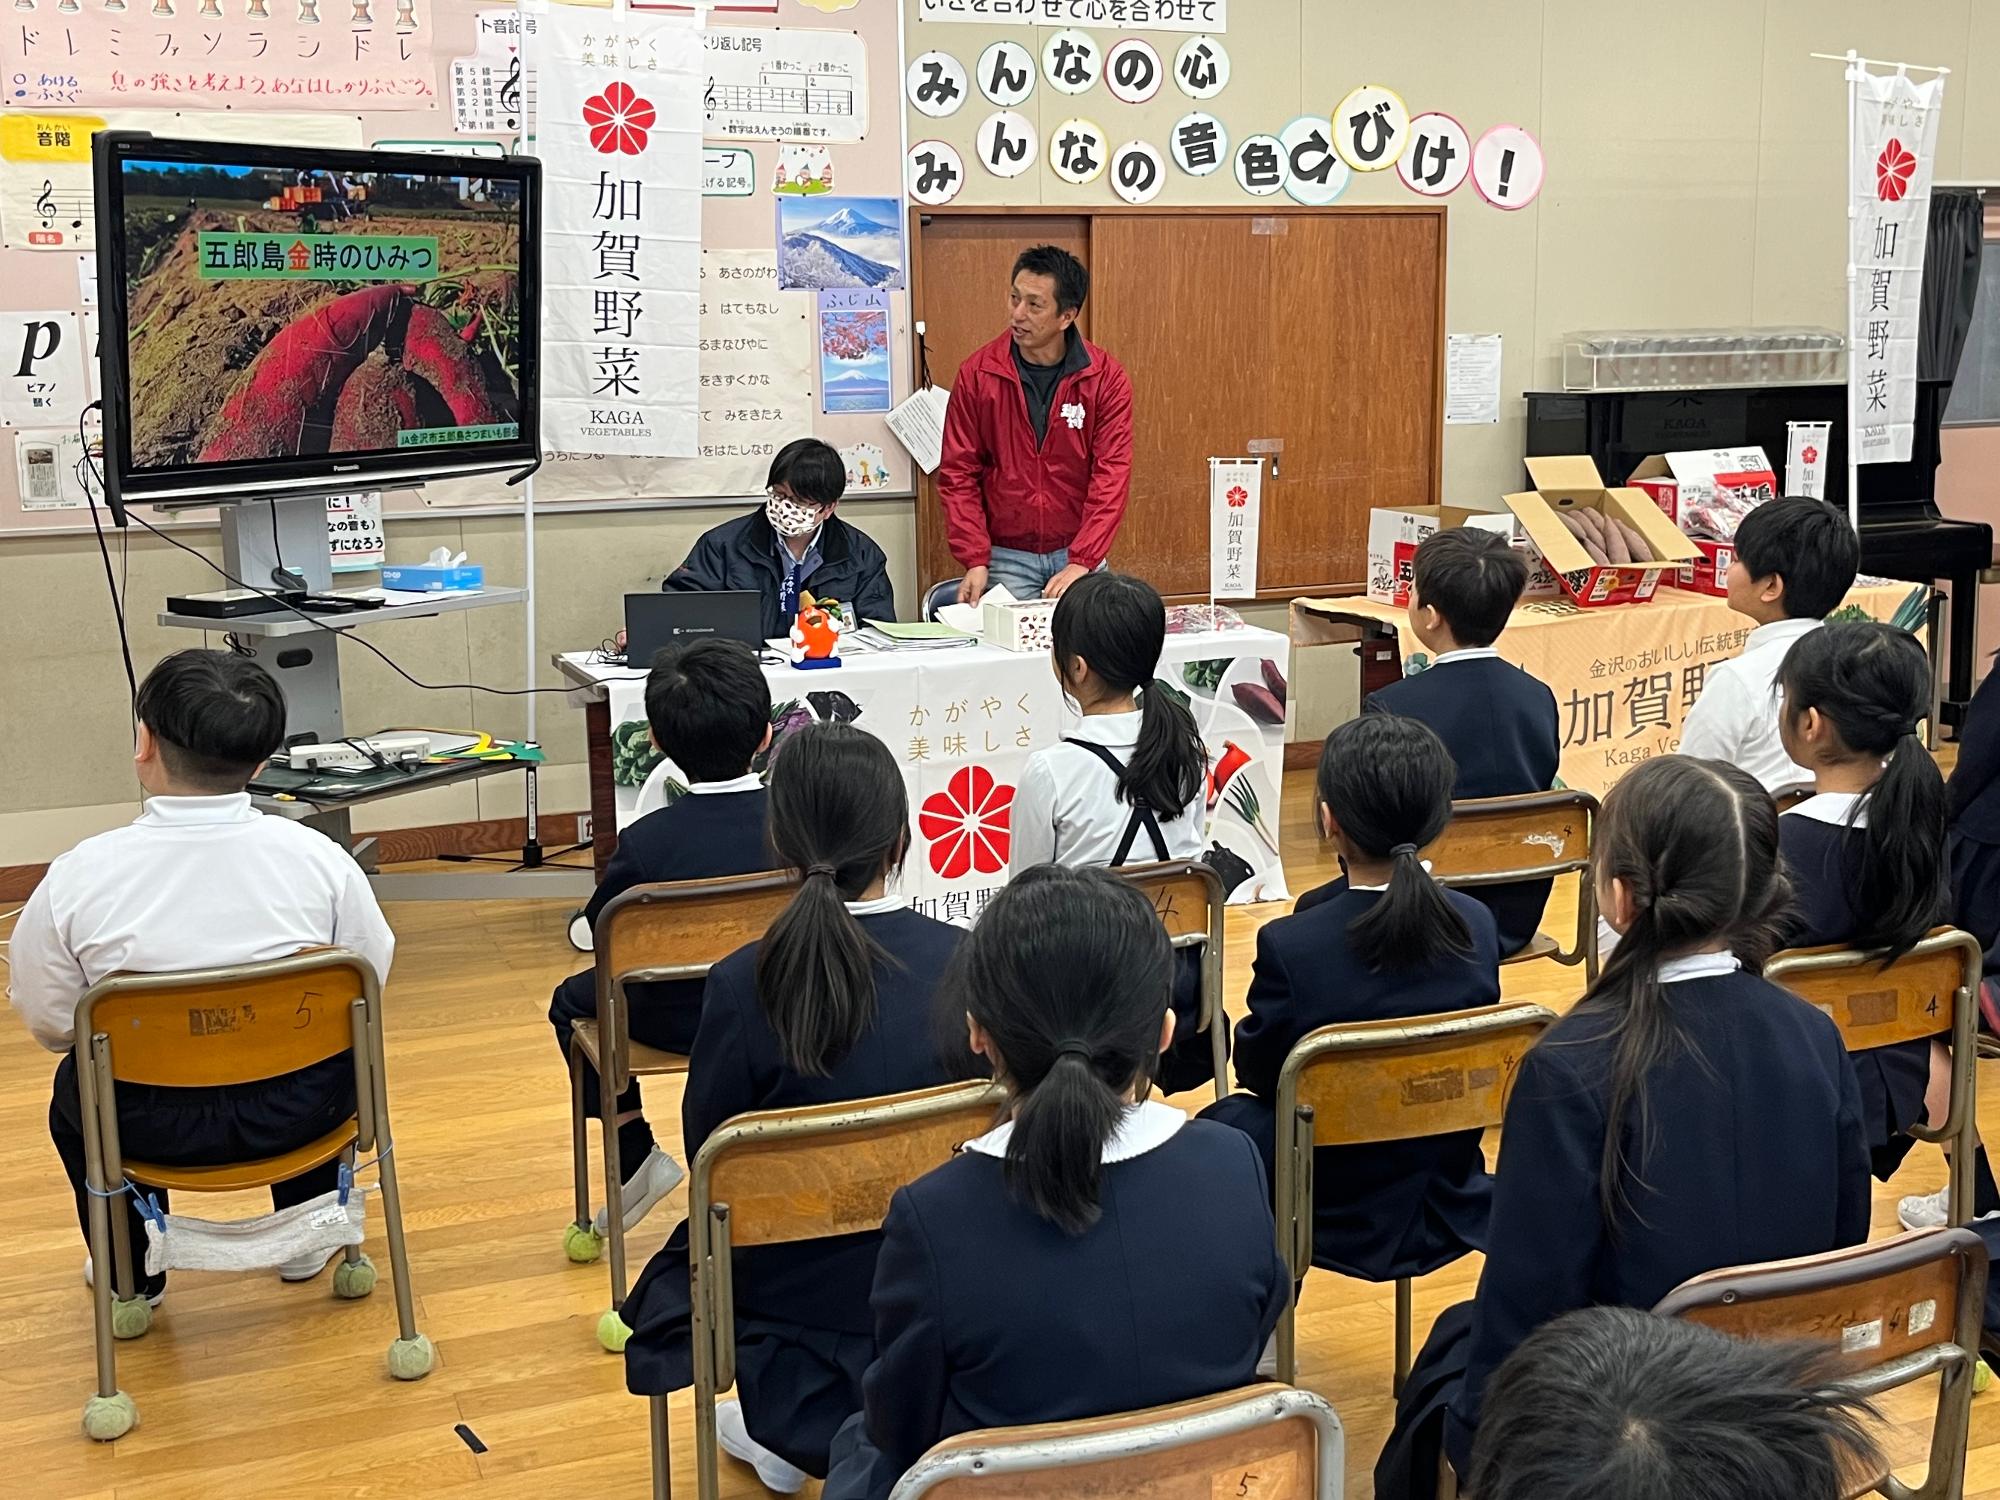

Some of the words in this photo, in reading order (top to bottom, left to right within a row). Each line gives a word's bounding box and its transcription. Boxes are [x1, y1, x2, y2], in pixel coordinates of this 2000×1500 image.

[584, 34, 657, 51] かがやく
[582, 52, 657, 70] 美味しさ
[37, 132, 71, 147] 音階
[205, 239, 432, 271] 五郎島金時のひみつ
[591, 170, 644, 397] 加賀野菜
[719, 267, 777, 279] あさのがわ
[720, 303, 779, 315] はてもなし
[1866, 216, 1899, 413] 加賀野菜
[699, 338, 769, 351] るまなびやに
[27, 383, 56, 393] ピアノ
[591, 410, 644, 425] KAGA
[725, 409, 783, 421] みをきたえ
[580, 427, 651, 437] VEGETABLES
[1226, 512, 1243, 579] 加賀野菜
[1589, 627, 1757, 680] 金沢のおいしい伝統野
[909, 693, 1031, 727] かがやく
[908, 725, 1032, 762] 美味しさ
[294, 992, 323, 1029] 5
[1925, 993, 1938, 1018] 4
[1237, 1471, 1258, 1497] 5
